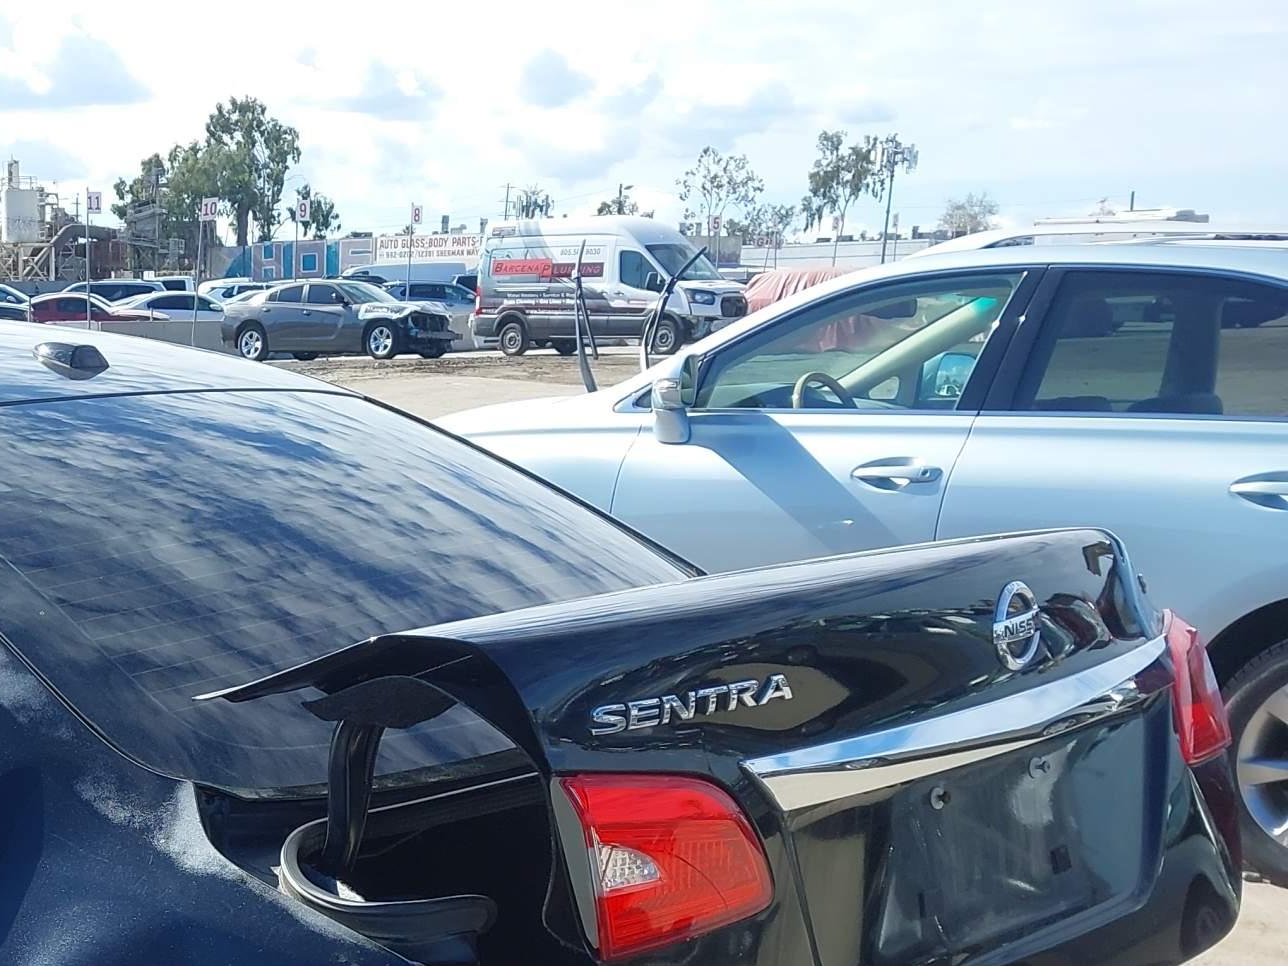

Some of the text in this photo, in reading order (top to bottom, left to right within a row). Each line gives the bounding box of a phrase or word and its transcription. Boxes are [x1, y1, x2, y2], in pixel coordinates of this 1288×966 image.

[87, 195, 101, 211] 11
[202, 202, 218, 217] 10
[299, 202, 307, 218] 9
[413, 207, 420, 223] 8
[713, 216, 720, 230] 5
[379, 239, 399, 249] AUTO
[589, 673, 794, 736] SENTRA
